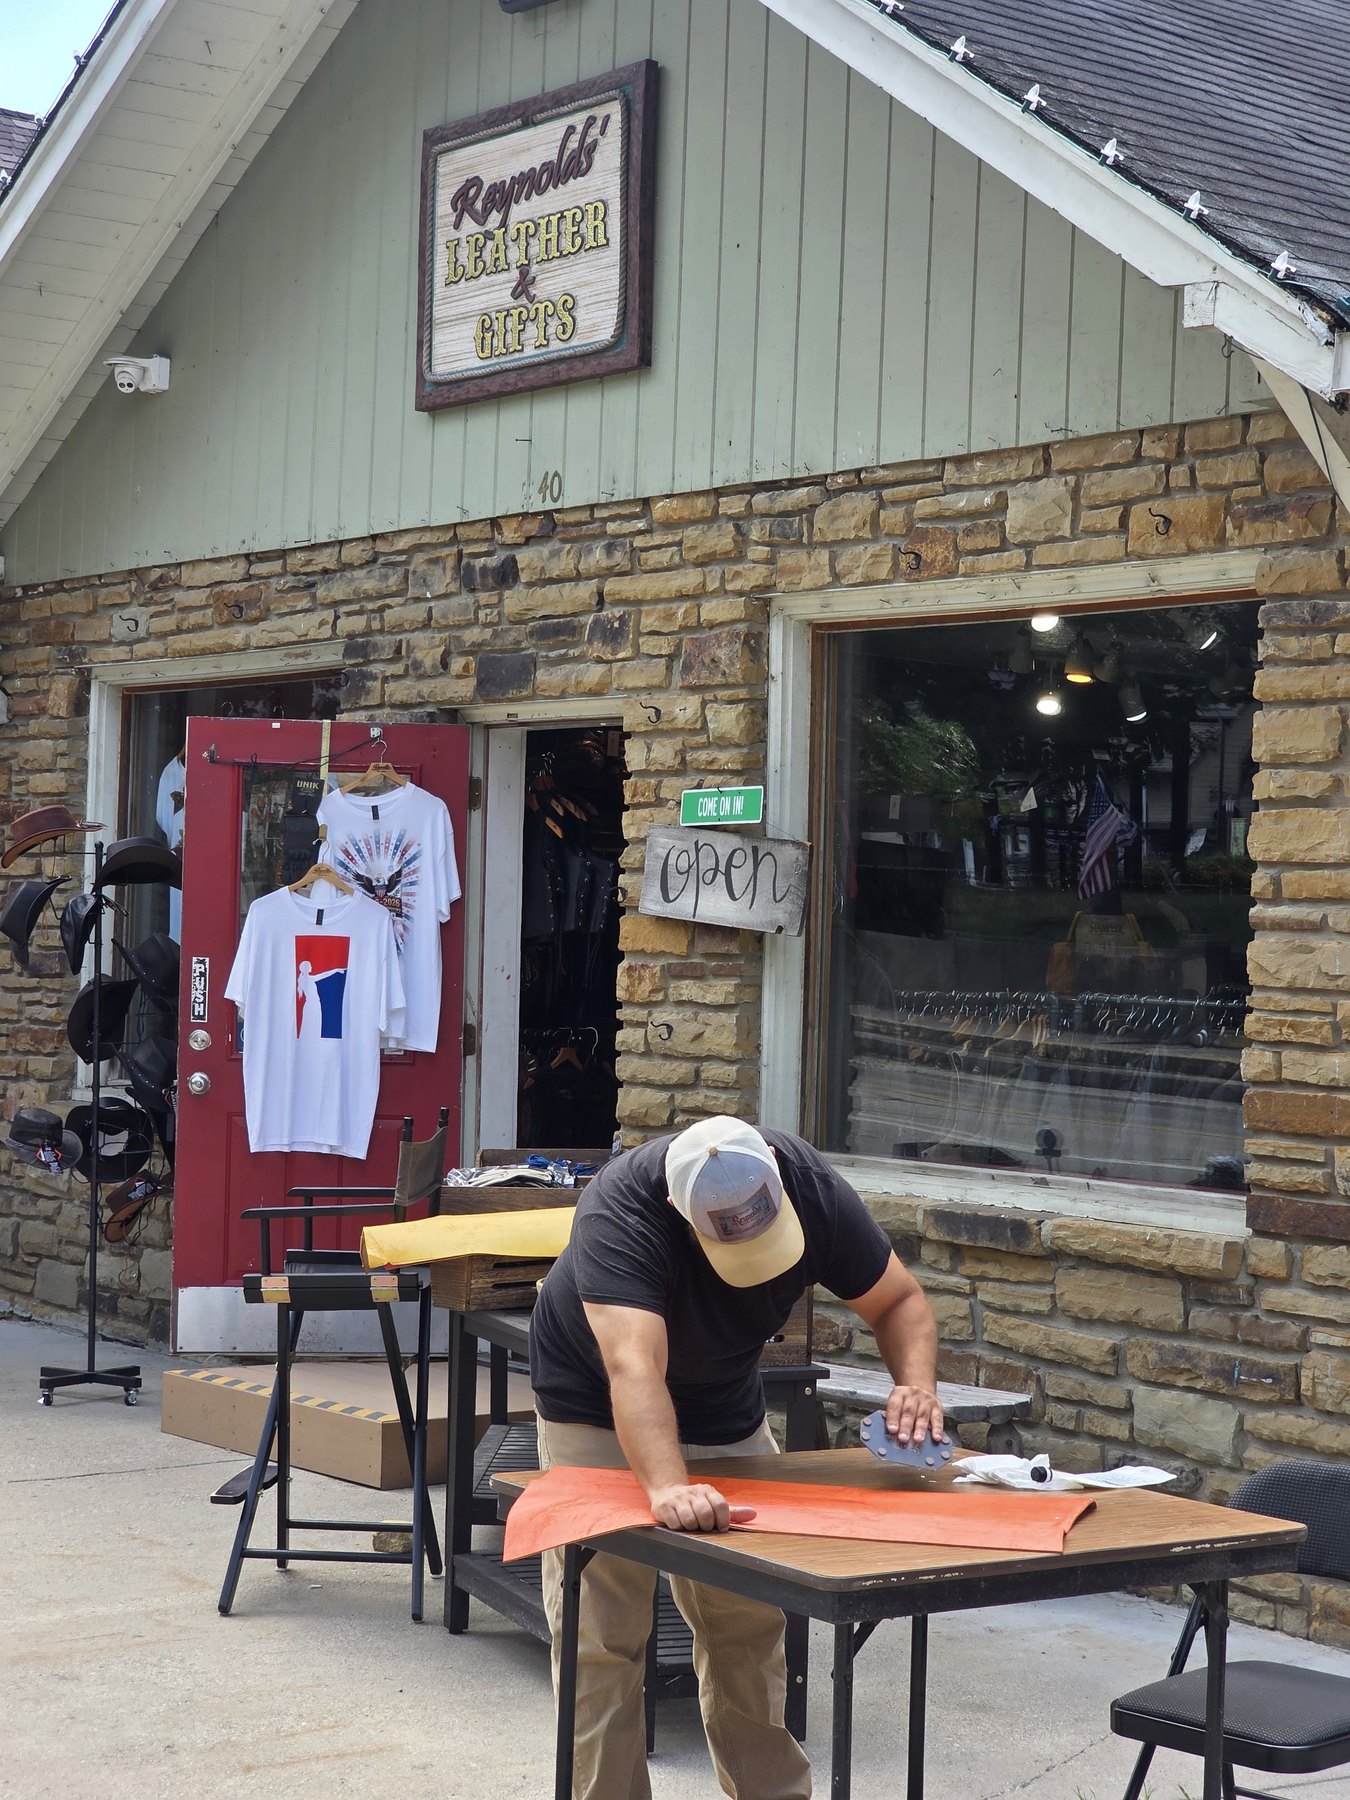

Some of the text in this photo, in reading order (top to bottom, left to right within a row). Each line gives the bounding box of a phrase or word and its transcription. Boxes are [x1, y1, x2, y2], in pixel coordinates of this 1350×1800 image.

[444, 200, 610, 286] LEATHER
[510, 266, 537, 304] &
[473, 293, 579, 361] GIFTS
[538, 470, 562, 503] 40
[296, 780, 319, 790] UNIK
[697, 794, 745, 818] COME ON IN!
[660, 838, 791, 920] open
[193, 962, 206, 1017] PUSH
